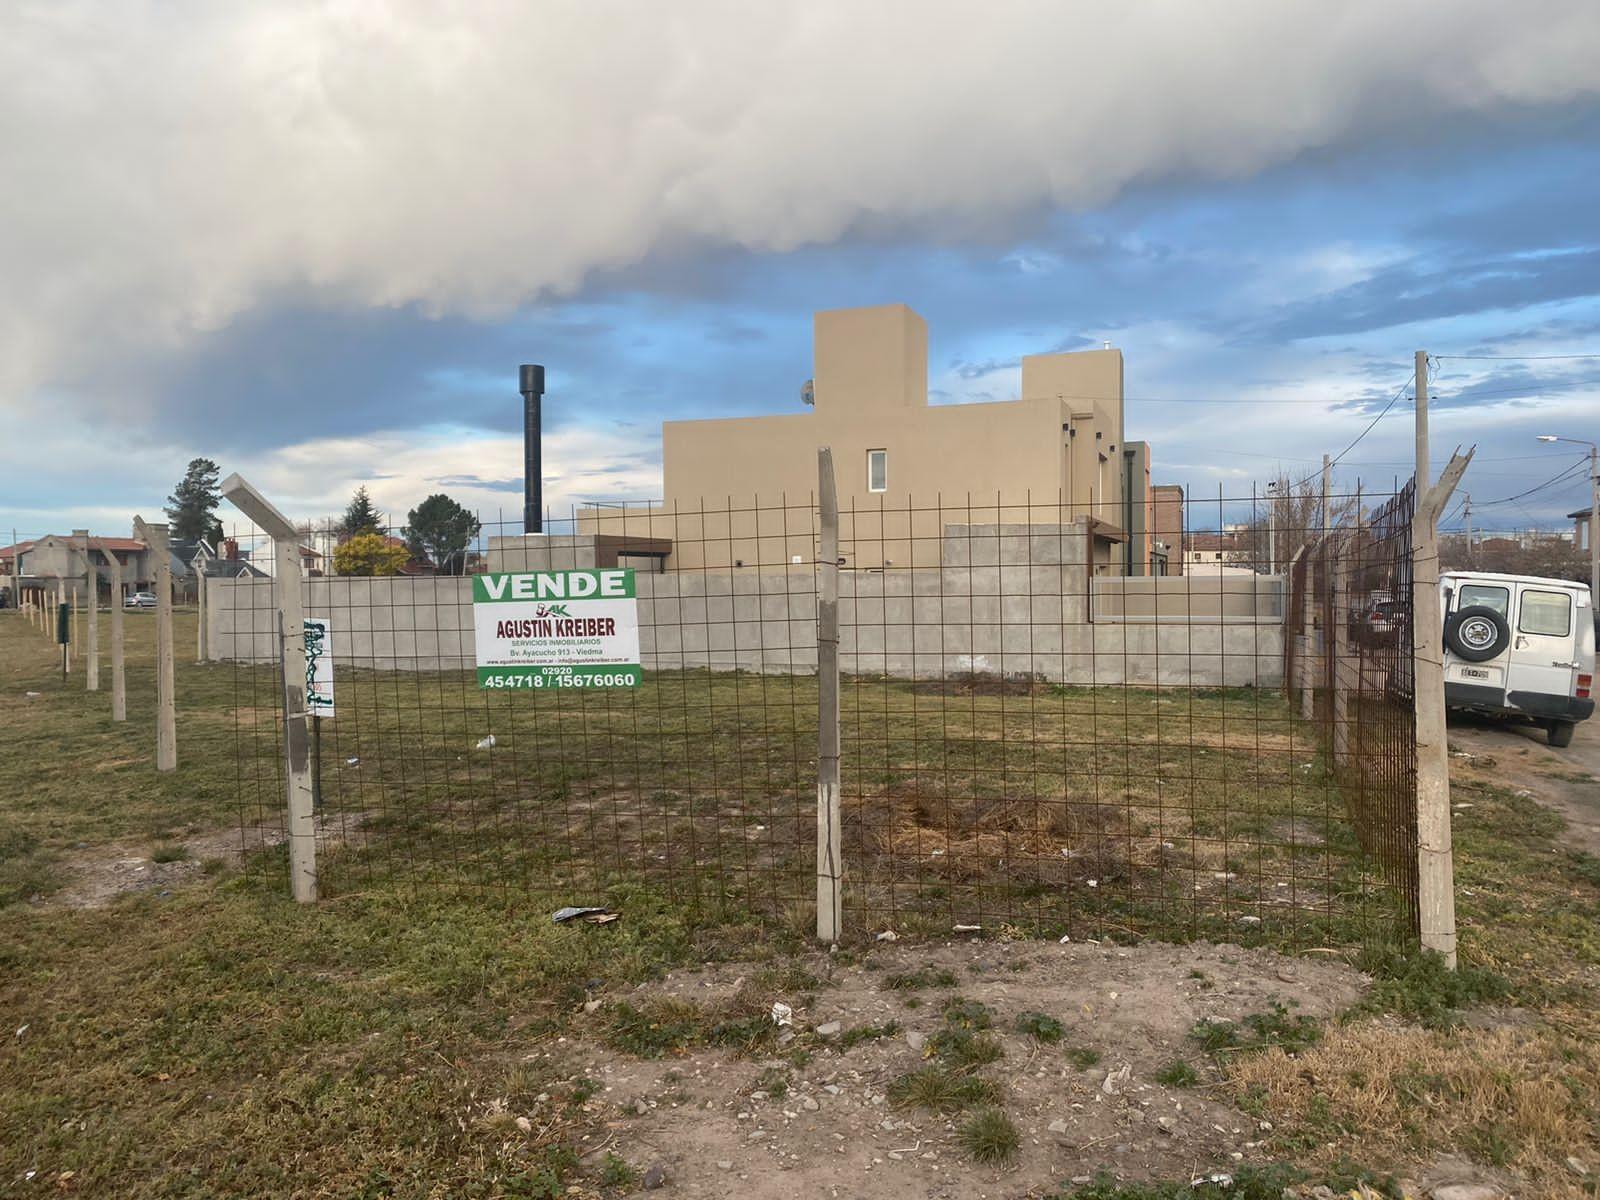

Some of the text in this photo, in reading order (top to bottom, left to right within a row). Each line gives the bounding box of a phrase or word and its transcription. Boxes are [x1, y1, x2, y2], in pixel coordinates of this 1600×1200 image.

[481, 570, 626, 600] VENDE
[496, 618, 616, 639] AGUSTIN KREIBER
[511, 638, 601, 647] SERVICIOS INMOBILIARIOS
[510, 649, 521, 657] Bv.
[522, 648, 556, 657] Ayacucho
[557, 648, 571, 656] 913
[576, 647, 603, 656] Viedma
[542, 667, 572, 675] 02920
[485, 675, 543, 688] 454718
[555, 673, 635, 687] 15676060
